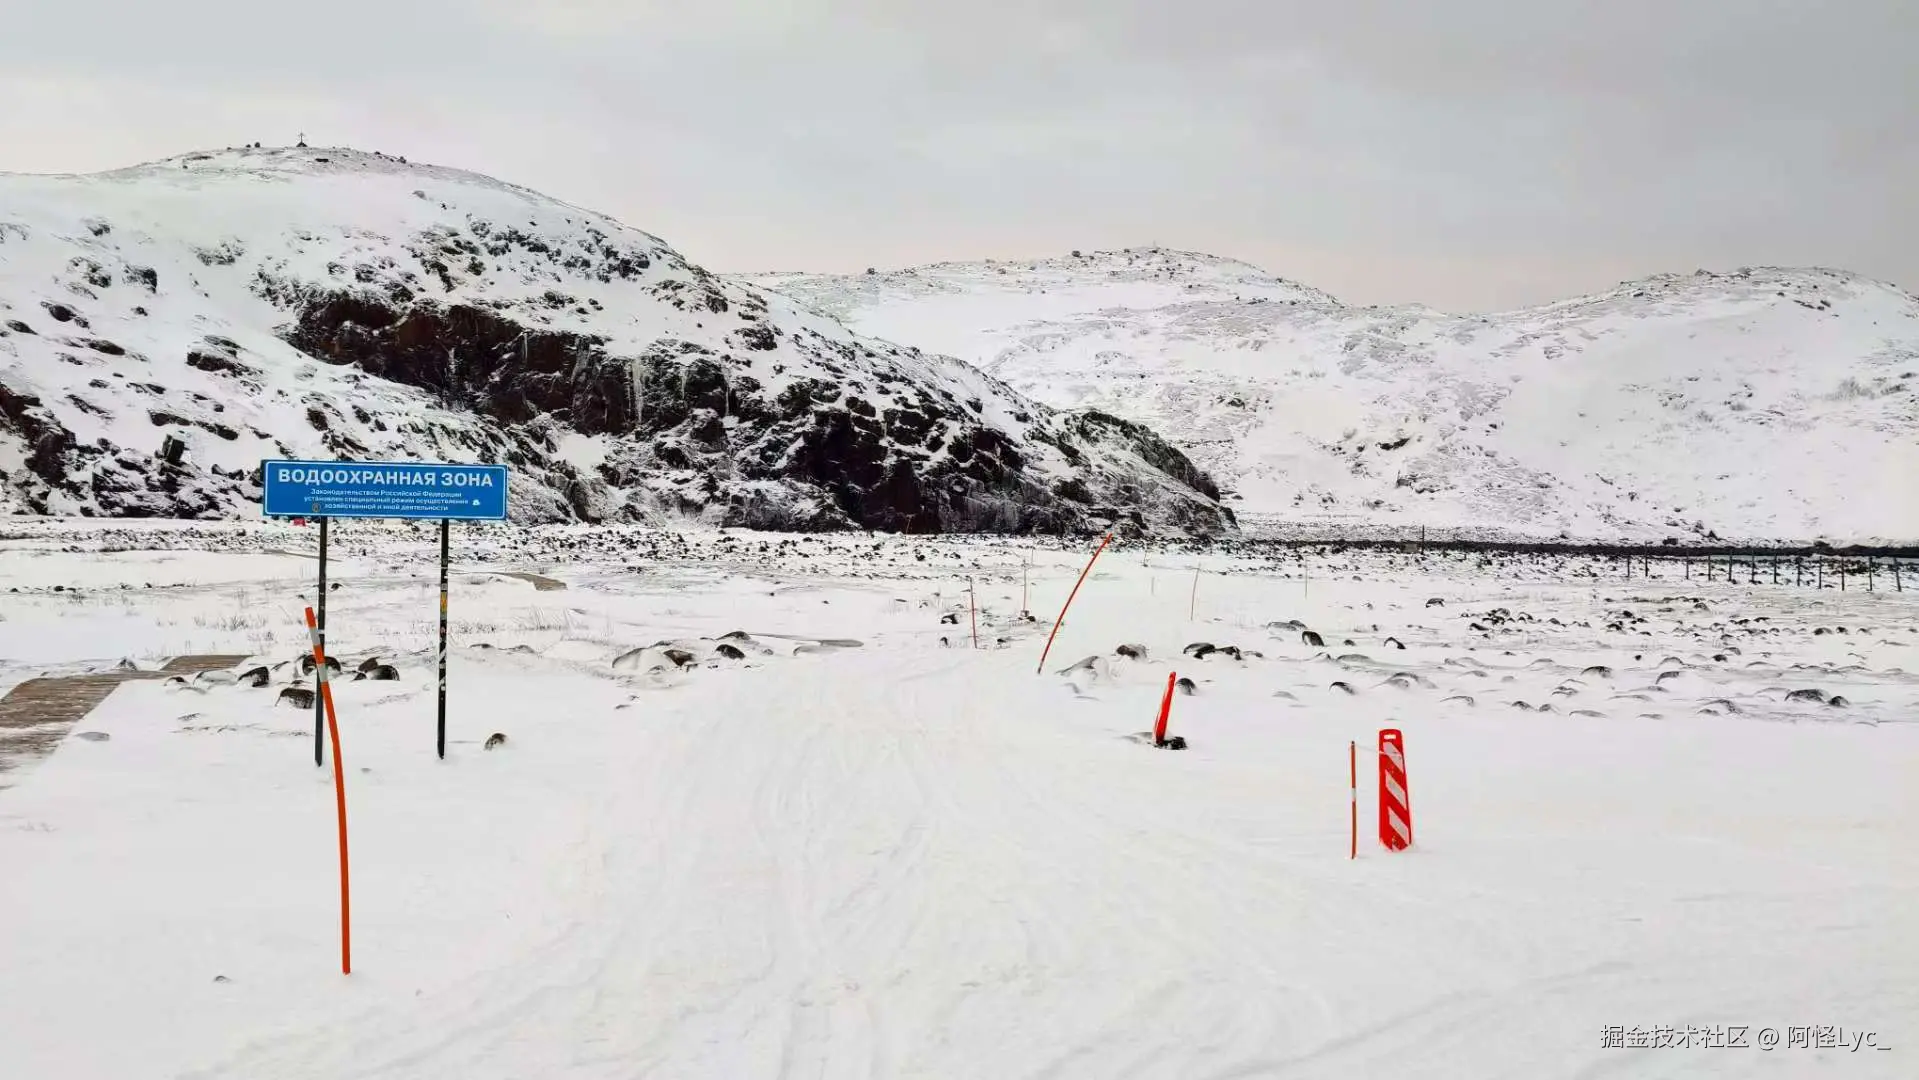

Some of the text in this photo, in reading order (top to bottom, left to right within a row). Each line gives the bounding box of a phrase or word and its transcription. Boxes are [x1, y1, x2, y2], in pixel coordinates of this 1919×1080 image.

[278, 469, 493, 487] ВОДООХРАННАЯ ЗОНА
[381, 490, 422, 498] Российской
[423, 490, 462, 499] Федерации
[344, 496, 391, 504] специальный
[383, 503, 400, 511] иной
